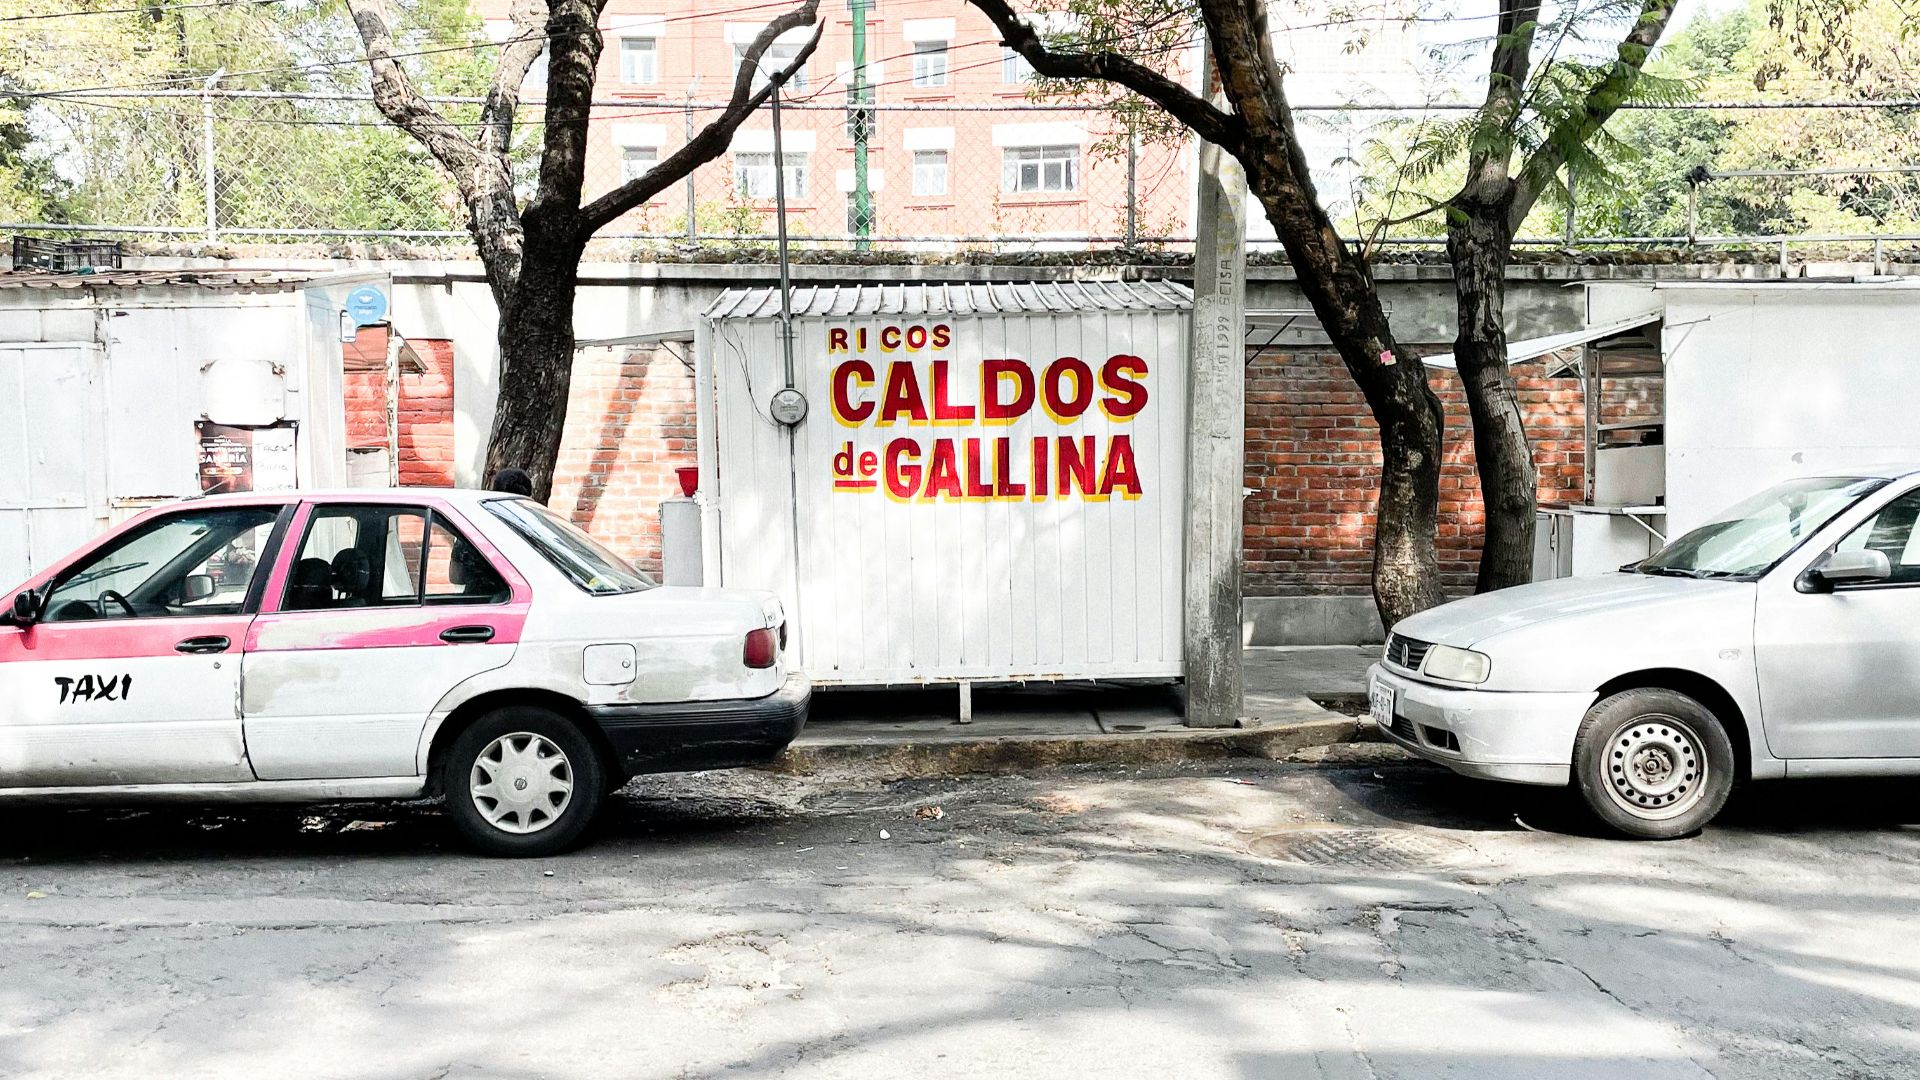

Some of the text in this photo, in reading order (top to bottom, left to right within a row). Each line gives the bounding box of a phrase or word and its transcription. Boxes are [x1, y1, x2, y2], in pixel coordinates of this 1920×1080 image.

[829, 324, 951, 352] RICOS
[1216, 317, 1230, 349] 1999
[830, 355, 1149, 428] CALDOS
[199, 453, 247, 463] SARÍA
[833, 434, 1143, 504] de GALLINA
[54, 673, 132, 705] TAXI
